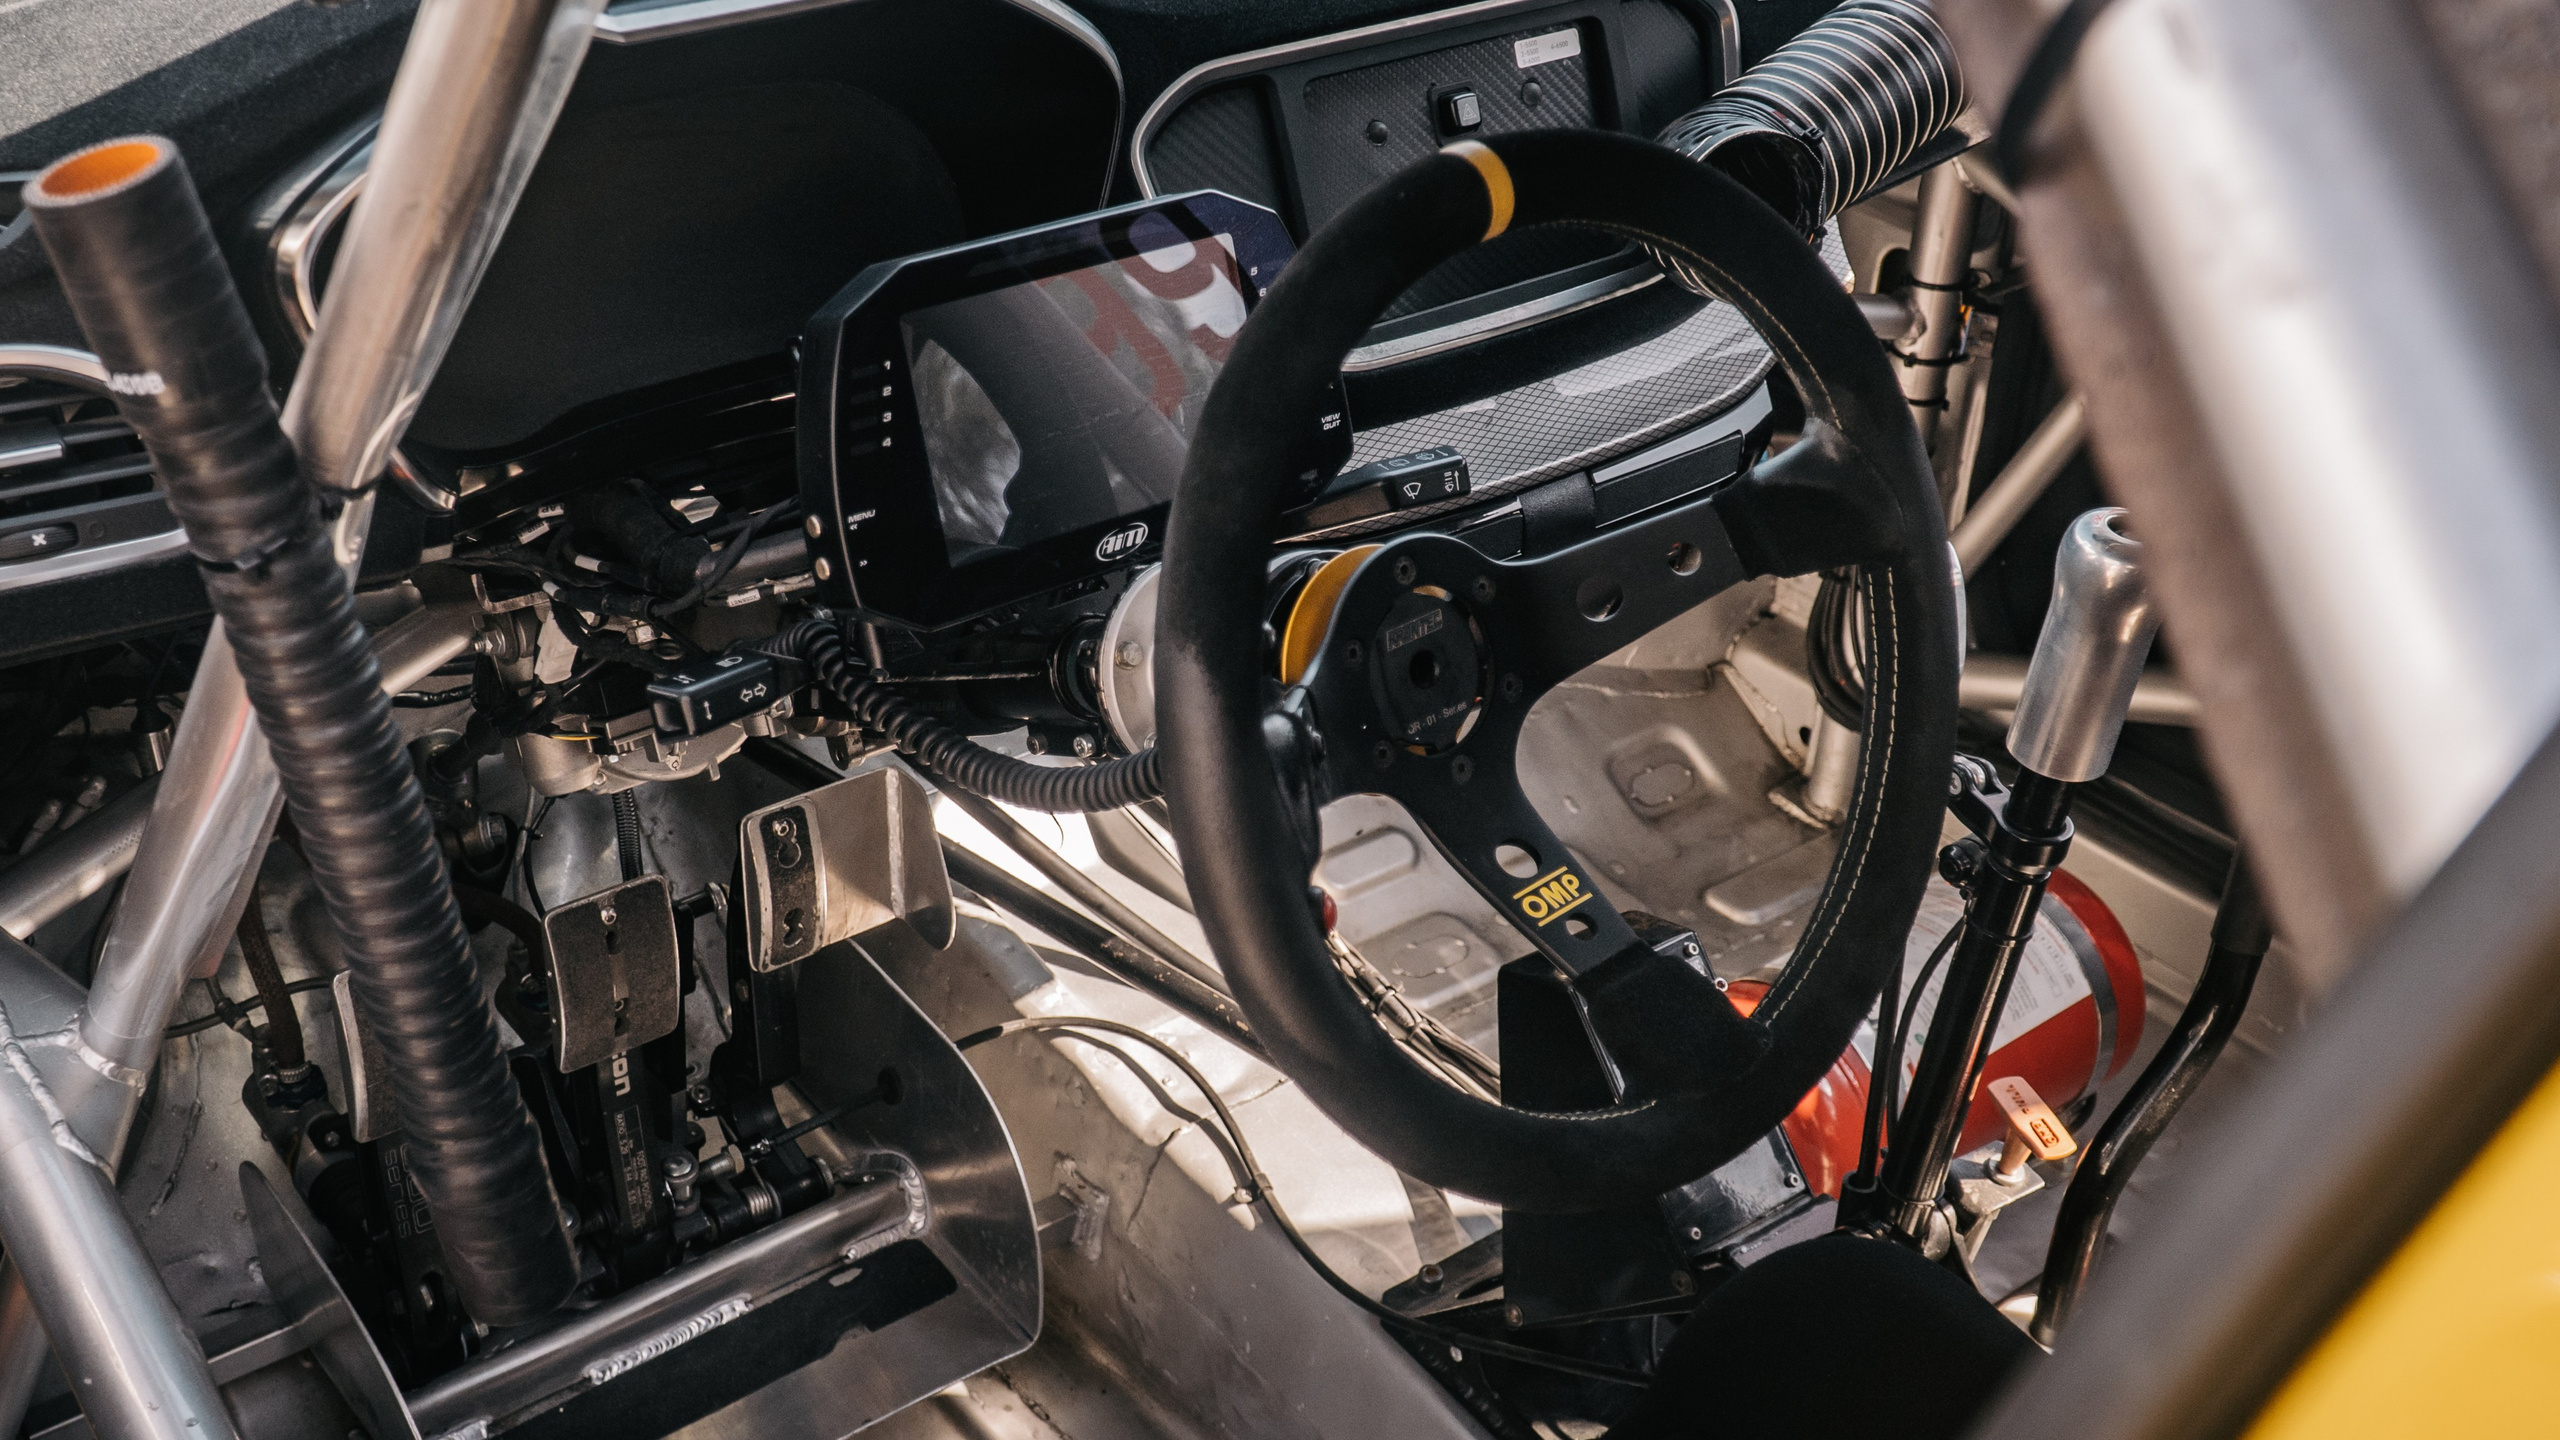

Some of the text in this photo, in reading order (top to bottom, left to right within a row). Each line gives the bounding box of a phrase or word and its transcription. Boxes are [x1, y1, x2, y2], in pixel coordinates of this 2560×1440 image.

[1250, 266, 1258, 276] 5
[1259, 287, 1267, 297] 6
[884, 360, 891, 370] 1
[882, 386, 892, 397] 2
[882, 411, 892, 423] 3
[1320, 412, 1341, 424] VIEW
[1323, 419, 1342, 431] QUIT
[882, 436, 892, 447] 4
[848, 509, 876, 524] MENU
[1426, 714, 1437, 726] 01
[1442, 701, 1468, 719] Series
[1522, 873, 1580, 919] OMP
[385, 1148, 412, 1239] series
